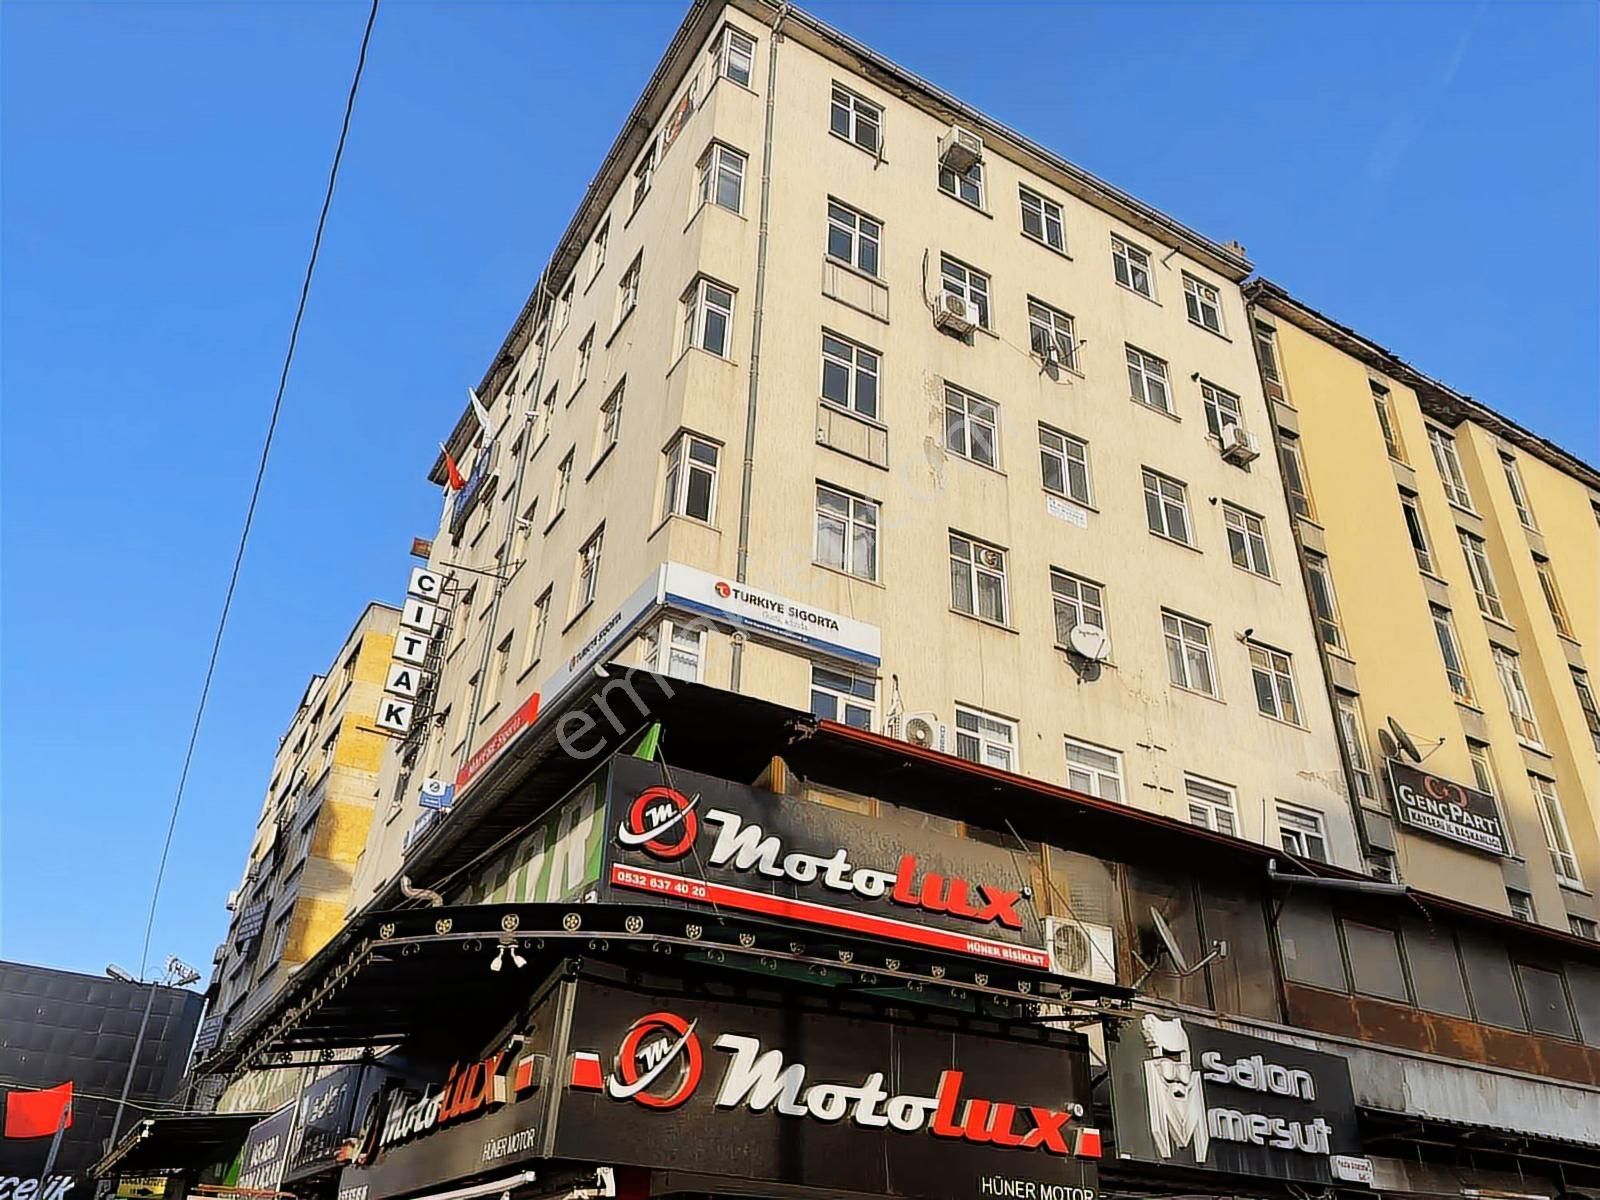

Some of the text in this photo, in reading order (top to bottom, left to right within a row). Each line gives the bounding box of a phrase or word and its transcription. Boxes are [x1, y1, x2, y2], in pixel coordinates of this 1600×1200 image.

[617, 871, 706, 897] 0532 637 40 20
[1201, 1051, 1316, 1101] salon
[1207, 1107, 1332, 1155] mesut
[981, 1175, 1036, 1199] HÜNER
